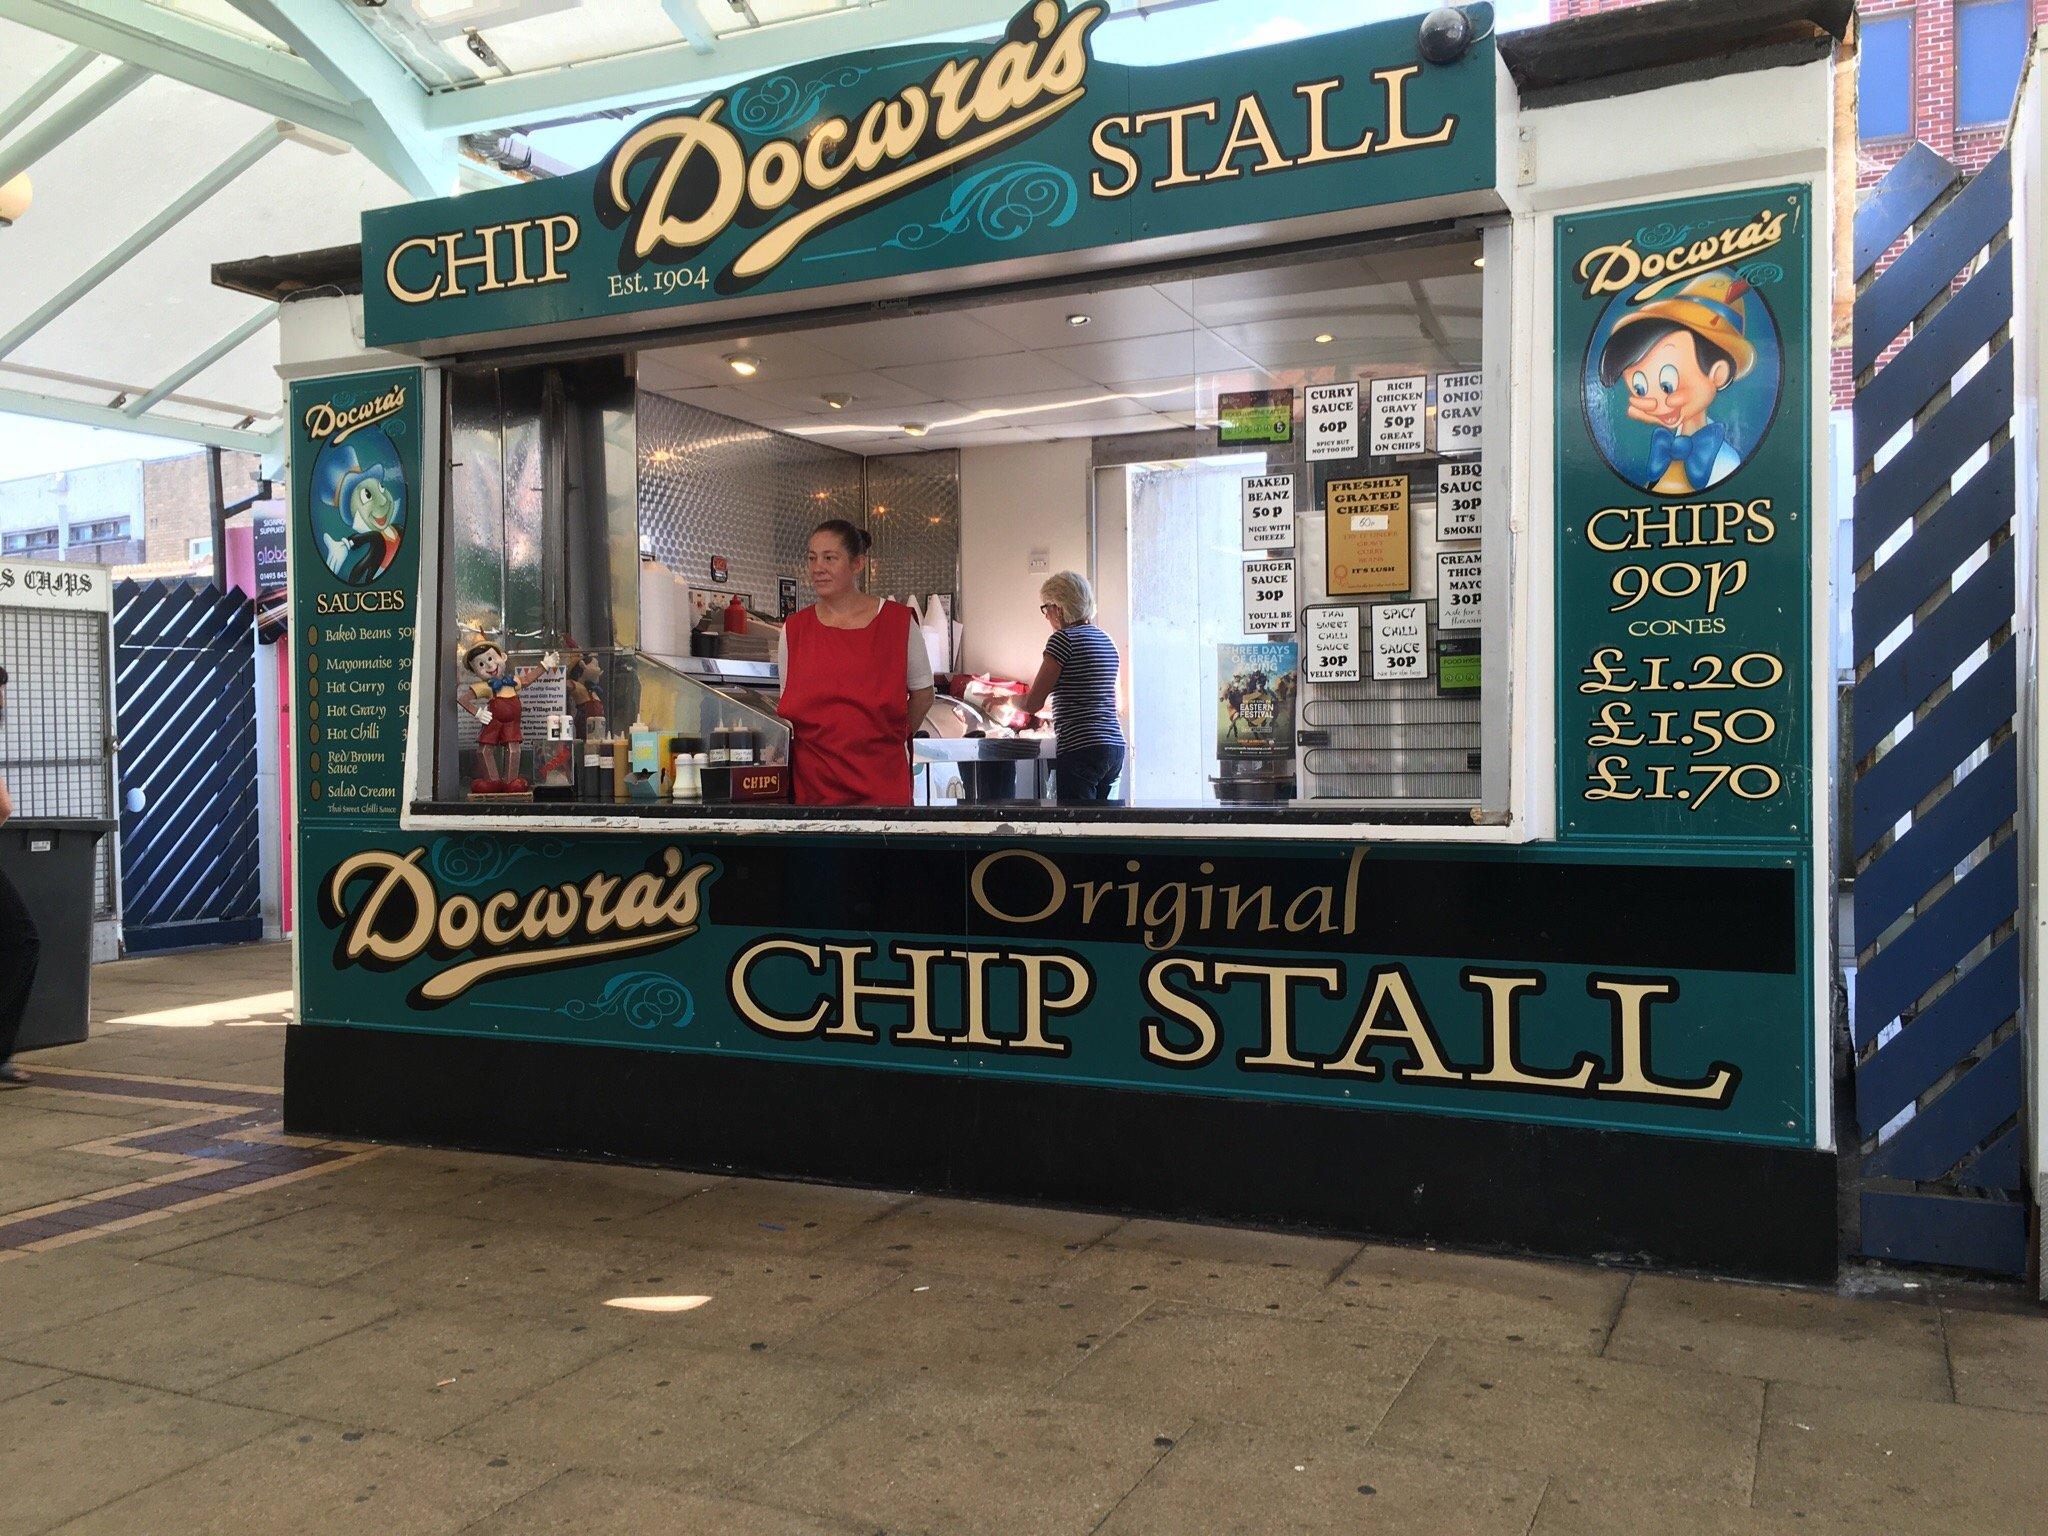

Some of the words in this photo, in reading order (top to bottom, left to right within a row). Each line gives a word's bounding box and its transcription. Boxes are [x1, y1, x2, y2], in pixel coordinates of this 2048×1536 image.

[610, 0, 1100, 258] Docwra's
[386, 215, 579, 302] CHIP
[1093, 66, 1455, 197] STALL
[1580, 209, 1787, 295] Docwra's
[607, 273, 648, 297] Est.
[653, 266, 709, 295] 1904
[1387, 382, 1412, 391] RICH
[1311, 387, 1354, 400] CURRY
[1376, 392, 1423, 403] CHICKEN
[1443, 391, 1482, 403] ONIO
[305, 384, 405, 439] Docwra's
[1312, 402, 1354, 414] SAUCE
[1381, 404, 1417, 413] GRAVY
[1441, 407, 1482, 419] GRAV
[1319, 421, 1347, 432] 60p
[1384, 416, 1414, 428] 50p
[1380, 432, 1413, 440] GREAT
[1392, 442, 1420, 450] CHIPS
[1451, 464, 1482, 476] BBQ
[1247, 476, 1290, 488] BAKED
[1332, 478, 1404, 492] FRESHLY
[1440, 481, 1482, 493] SAUC
[1248, 491, 1289, 501] BEANZ
[1335, 490, 1401, 503] GRATED
[1336, 503, 1399, 514] CHEESE
[1456, 514, 1475, 522] IT'S
[1587, 499, 1776, 551] CHIPS
[1441, 555, 1481, 565] CREAM
[1247, 562, 1292, 573] BURGER
[24, 569, 93, 598] CHIPS
[1251, 575, 1288, 585] SAUCE
[1611, 559, 1748, 613] 90p
[317, 590, 405, 614] SAUCES
[1248, 612, 1279, 620] YOU'LL
[1322, 610, 1344, 618] THAI
[1383, 607, 1416, 619] SPICY
[1317, 621, 1348, 629] SWEET
[1628, 618, 1726, 636] CONES
[326, 624, 356, 642] Baked
[360, 628, 392, 640] Beans
[1319, 632, 1347, 640] CHILLI
[1382, 626, 1417, 637] CHILLI
[1262, 645, 1289, 655] DAYS
[1317, 643, 1349, 651] SAUCE
[1380, 643, 1420, 654] SAUCE
[326, 655, 392, 673] Mayonnaise
[1249, 654, 1285, 663] GREAT
[1580, 648, 1783, 693] £1.20
[327, 682, 347, 693] Hot
[350, 681, 385, 696] Curry
[327, 705, 347, 716] Hot
[350, 704, 386, 719] Gravy
[1240, 703, 1273, 711] EASTERN
[1240, 711, 1273, 719] FESTIVAL
[327, 728, 348, 739] Hot
[351, 722, 379, 741] Chilli
[1588, 702, 1776, 756] £1.50
[328, 763, 358, 774] Sauce
[743, 776, 777, 789] CHIPS
[1584, 755, 1781, 810] £1.70
[328, 781, 356, 797] Salad
[359, 785, 395, 797] Cream
[361, 803, 378, 813] Chilli
[380, 805, 396, 813] Sauce
[333, 845, 714, 960] Docwra's
[971, 847, 1373, 952] Original
[733, 940, 1090, 1051] CHIP
[1146, 961, 1732, 1102] STALL
